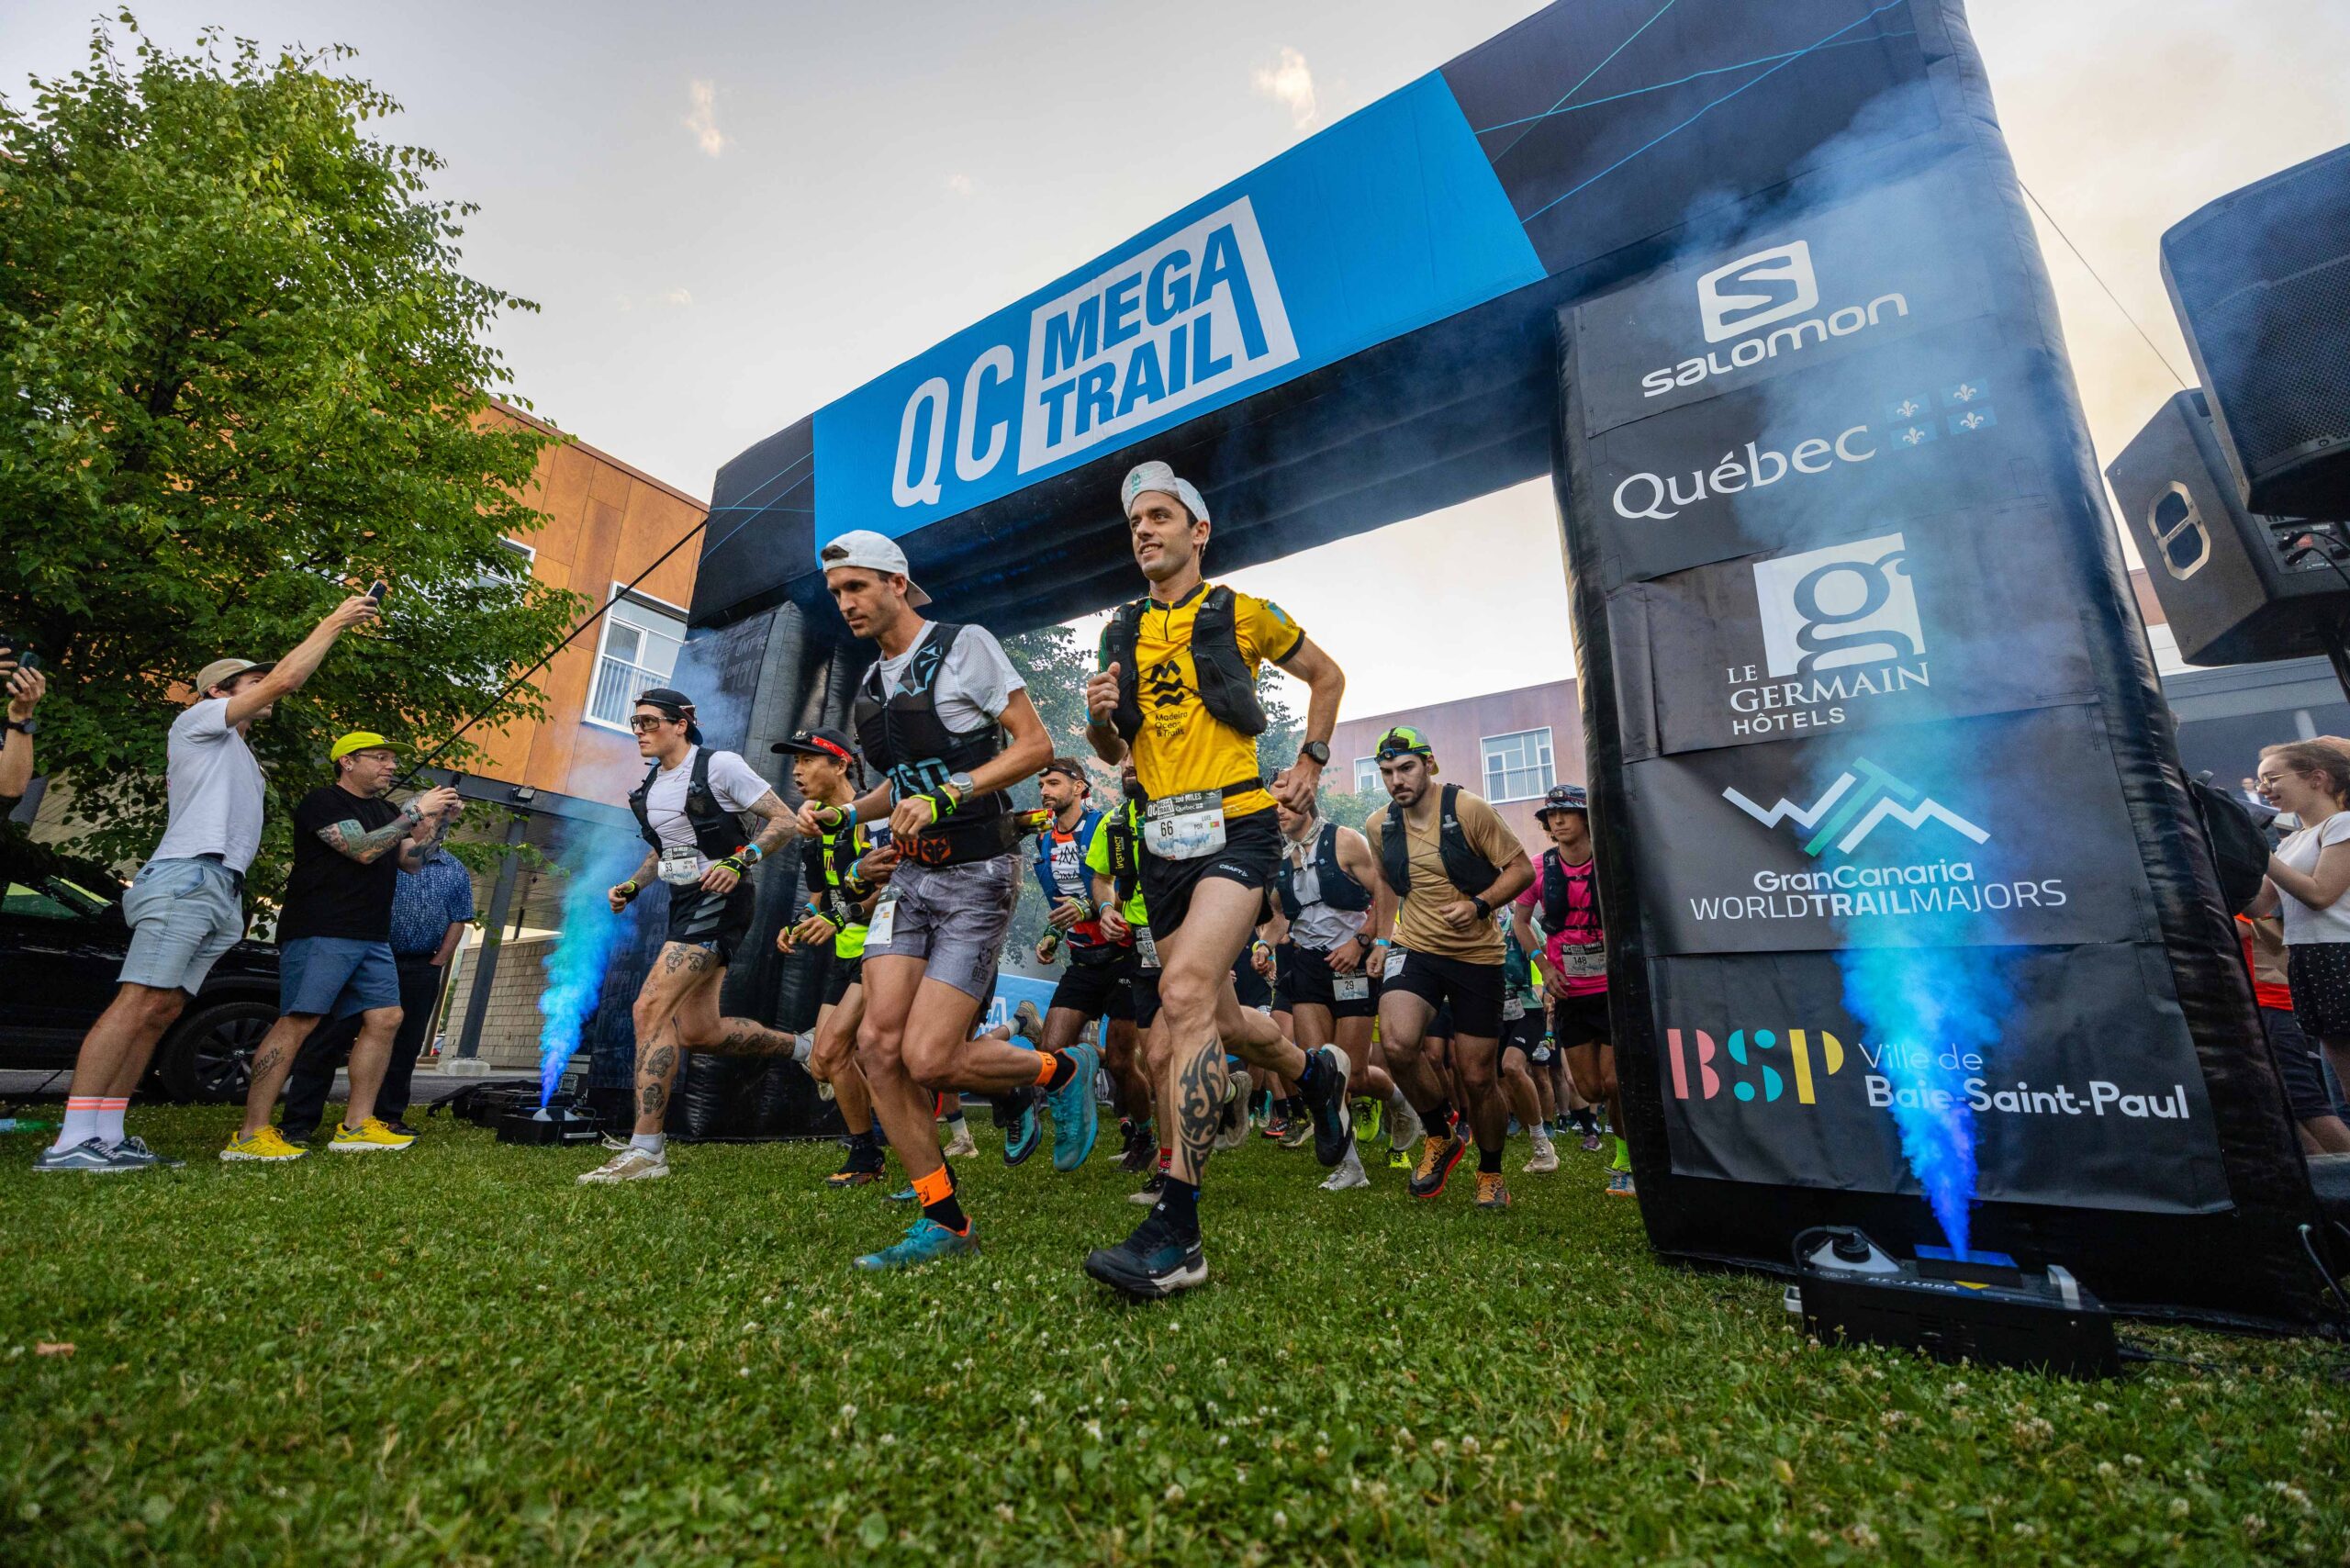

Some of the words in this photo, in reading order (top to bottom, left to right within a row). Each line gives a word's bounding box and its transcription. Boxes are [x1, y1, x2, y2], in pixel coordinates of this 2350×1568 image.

[1042, 223, 1269, 381] MEGA
[1040, 311, 1233, 449] TRAIL
[892, 345, 1014, 508] QC
[1613, 424, 1877, 520] Québec
[1727, 665, 1758, 684] LE
[1730, 661, 1930, 713] GERMAIN
[1156, 711, 1188, 722] Madeira
[1732, 706, 1846, 735] HÔTELS
[1147, 803, 1158, 817] QC
[1185, 792, 1202, 801] MILES
[1160, 821, 1174, 837] 66
[1219, 864, 1243, 874] CRAFT
[1754, 858, 1974, 892] GranCanaria
[1690, 879, 2067, 921] WORLDTRAILMAJORS
[1572, 957, 1587, 965] 148
[1345, 980, 1355, 991] 29
[1667, 1028, 1844, 1104] BSP
[1858, 1043, 1929, 1070] Ville
[1939, 1043, 1984, 1071] de
[1864, 1075, 2190, 1119] Baie-Saint-Paul
